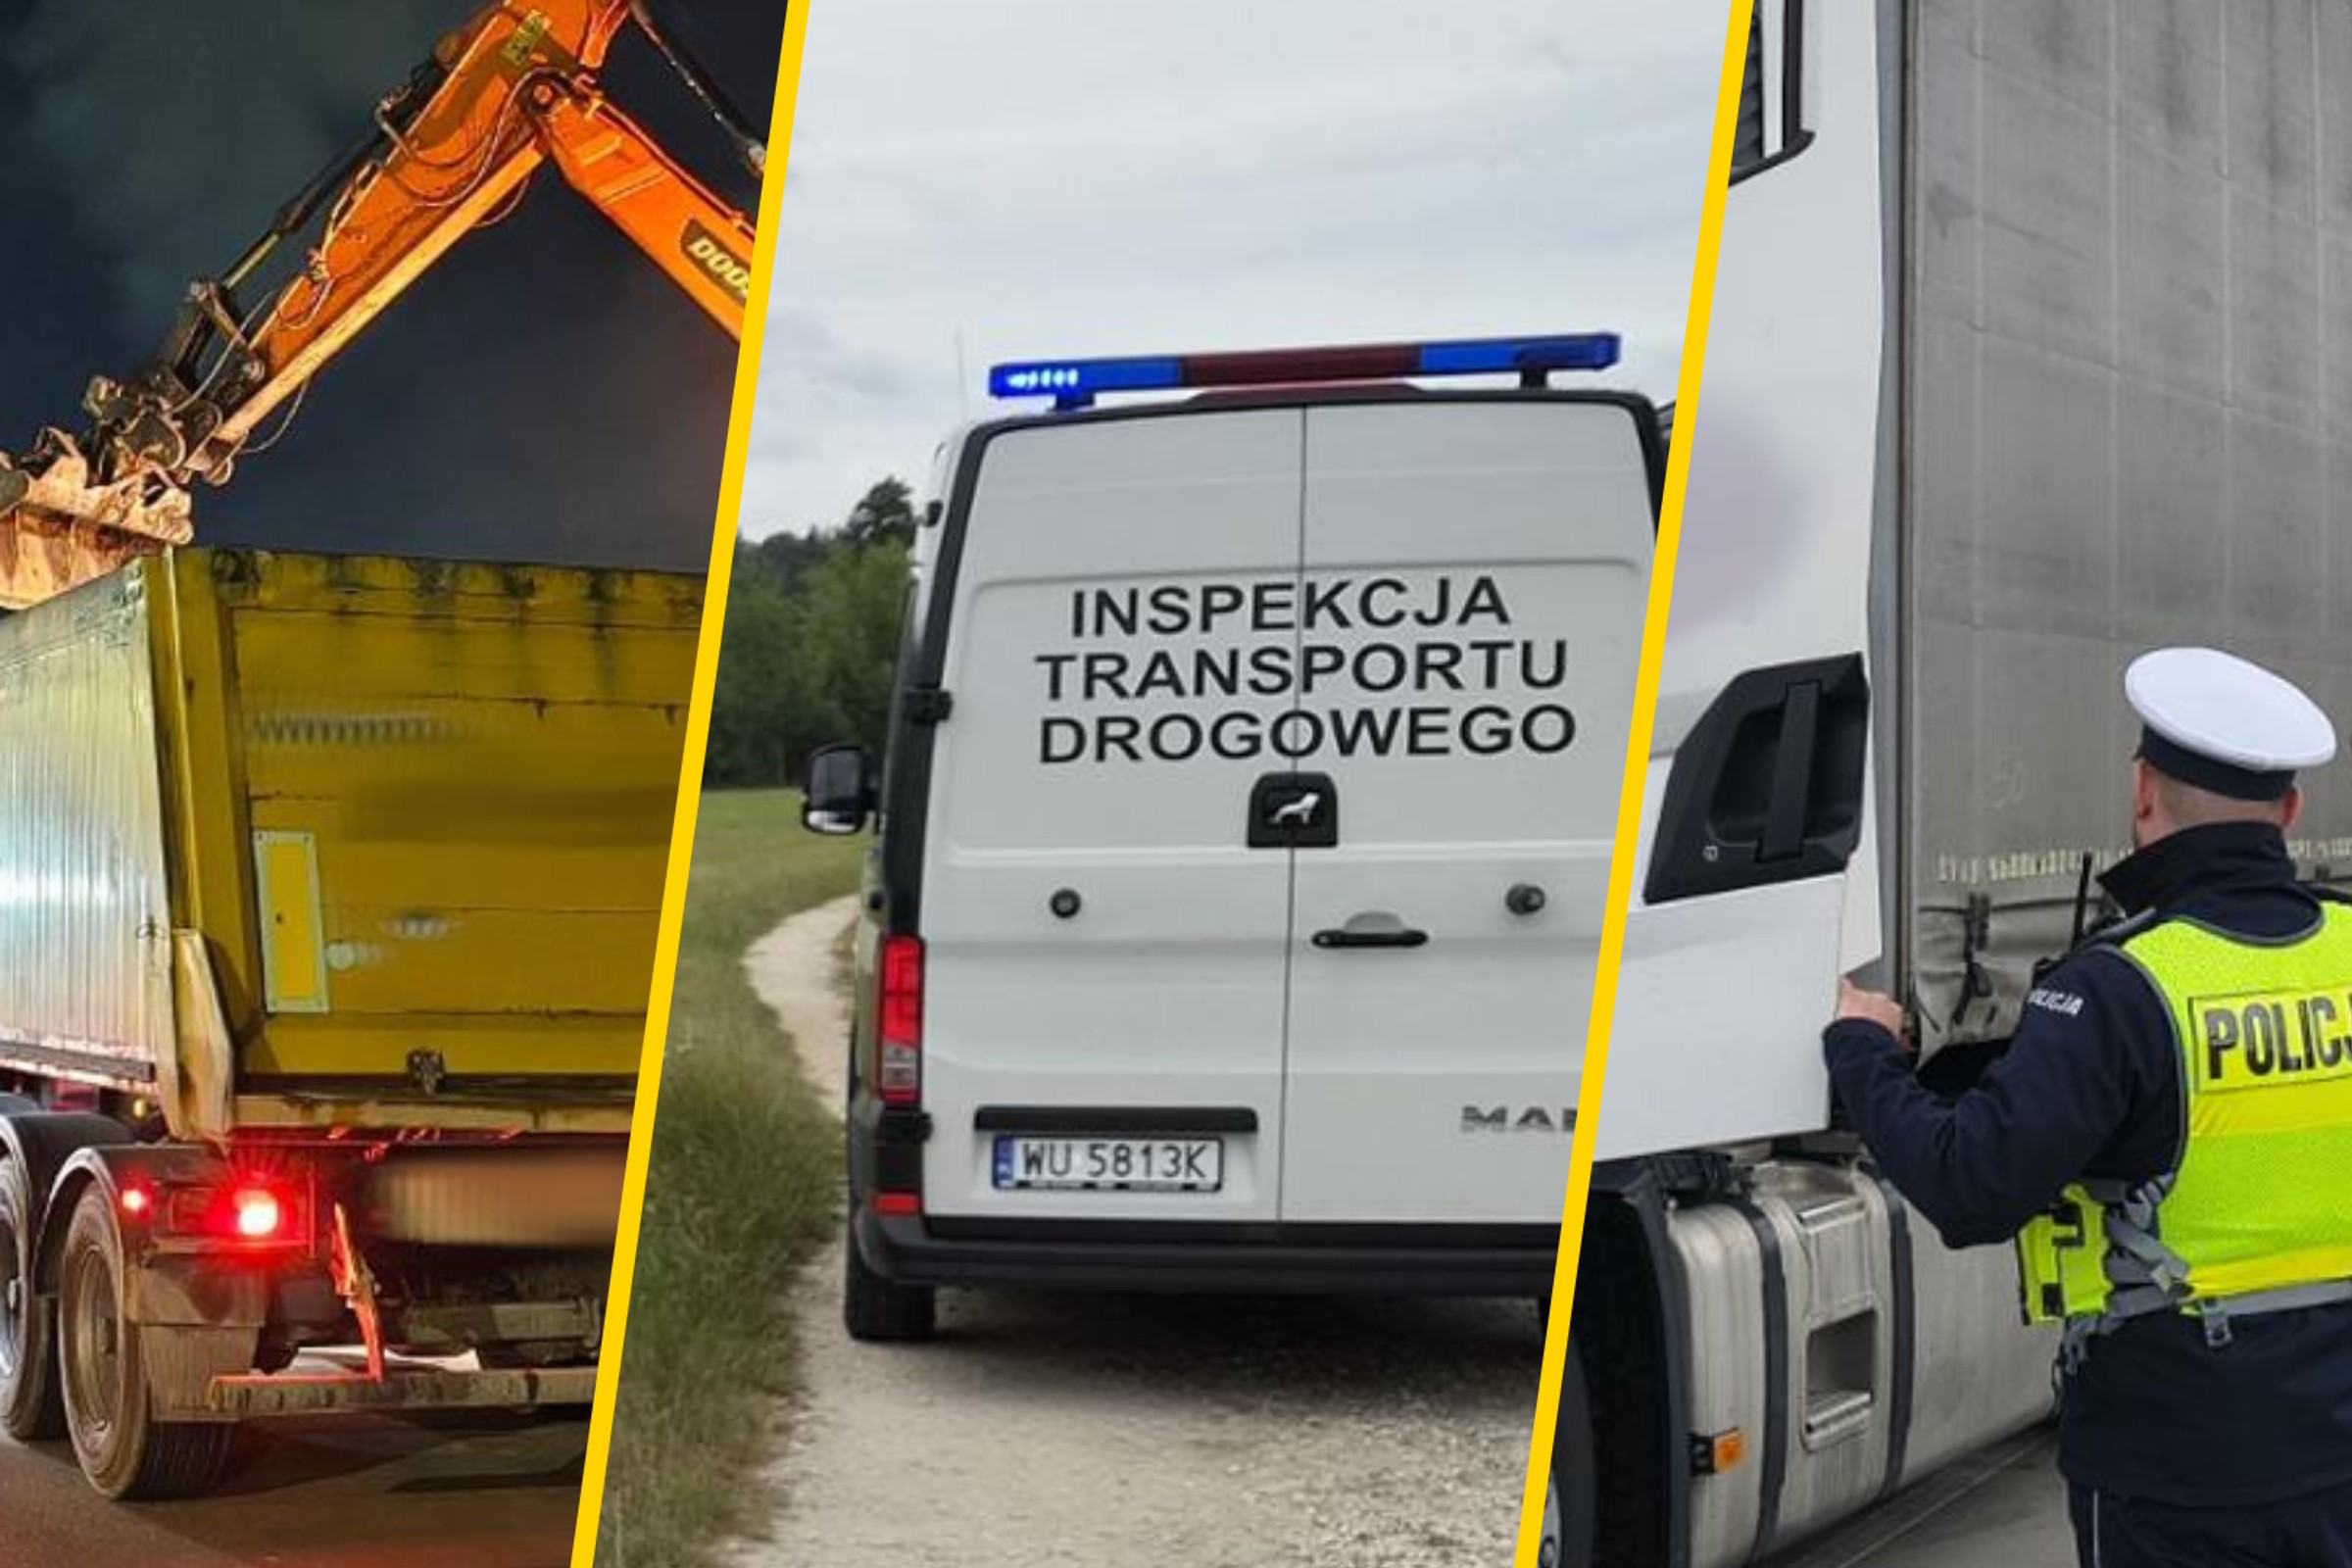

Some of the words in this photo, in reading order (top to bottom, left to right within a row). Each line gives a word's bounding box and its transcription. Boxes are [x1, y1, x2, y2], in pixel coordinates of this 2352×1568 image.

[687, 236, 749, 299] DOO
[1072, 575, 1511, 638] INSPEKCJA
[1035, 639, 1567, 701] TRANSPORTU
[1040, 704, 1577, 763] DROGOWEGO
[1022, 1143, 1071, 1176] WU
[1087, 1143, 1208, 1179] 5813K
